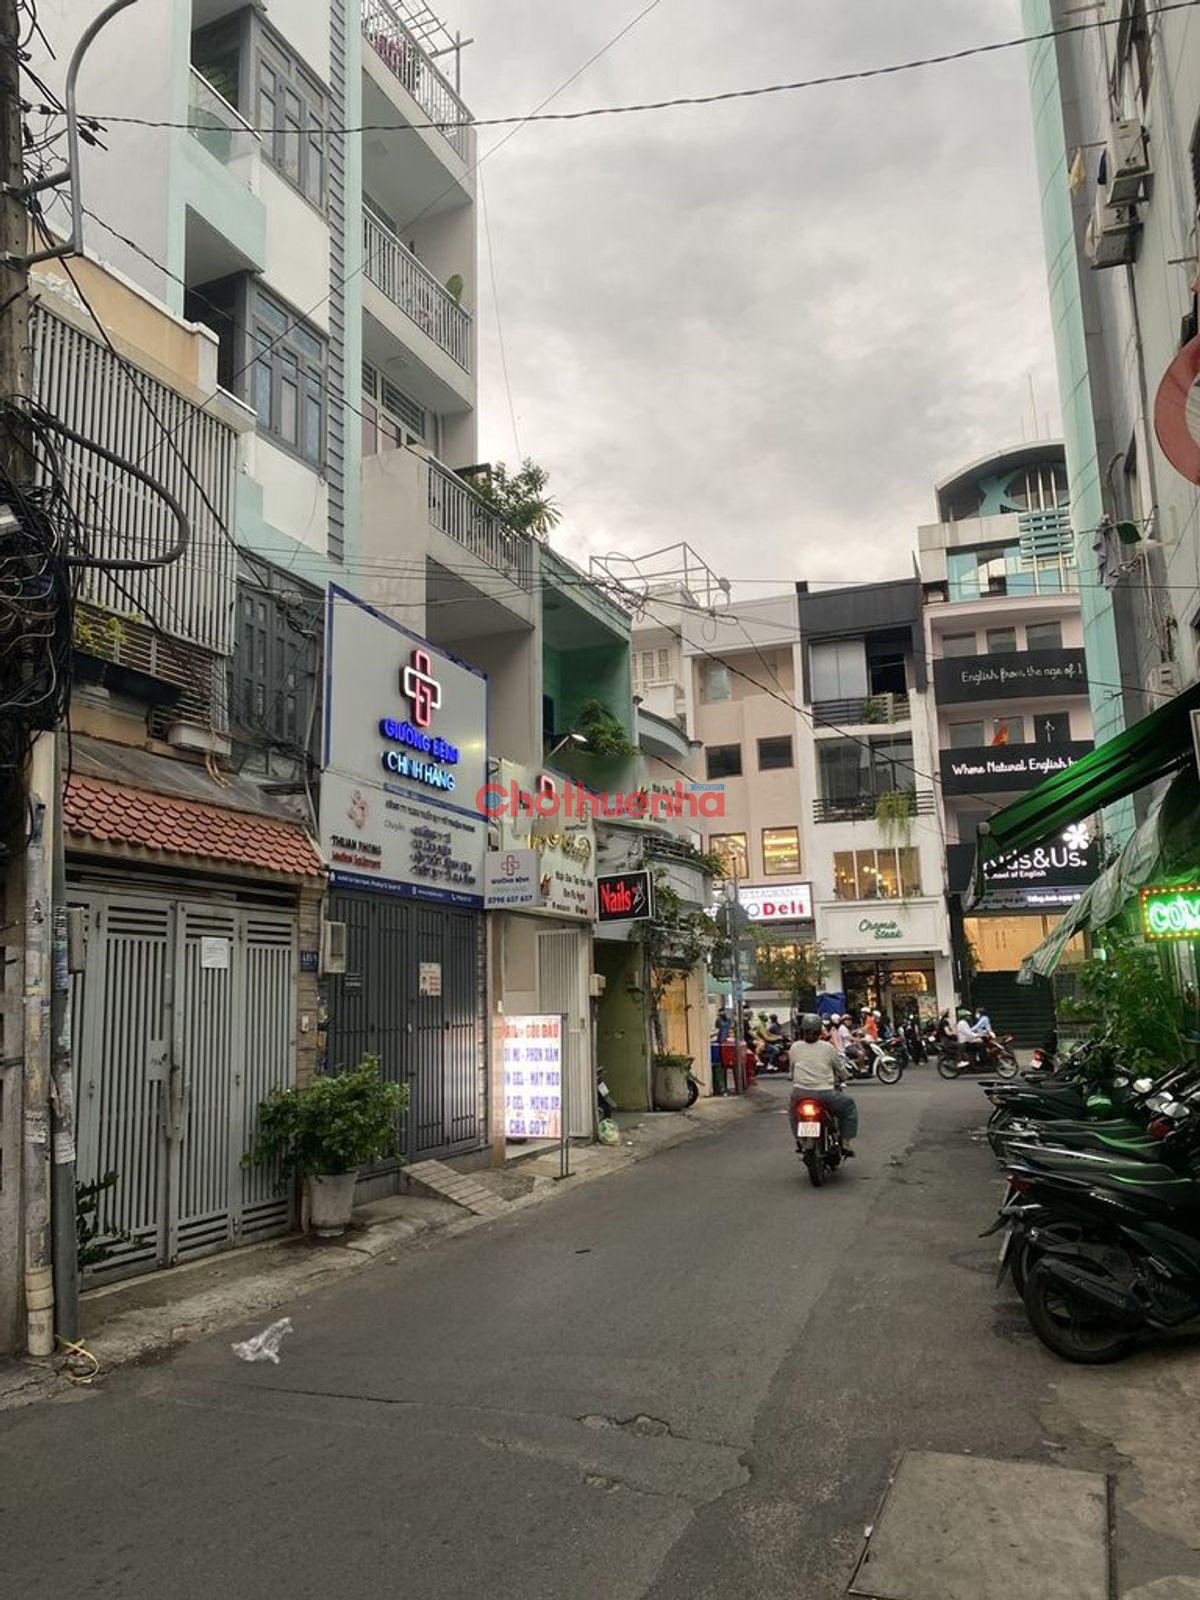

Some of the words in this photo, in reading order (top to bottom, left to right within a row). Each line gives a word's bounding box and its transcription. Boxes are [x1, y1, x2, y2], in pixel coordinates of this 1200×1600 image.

[961, 669, 1000, 685] English
[1026, 665, 1042, 677] the
[1044, 666, 1063, 680] age
[1064, 662, 1075, 677] of
[951, 763, 986, 776] Where
[986, 759, 1028, 774] Natural
[1028, 757, 1067, 774] English
[600, 880, 631, 913] Nails
[762, 901, 804, 916] Deli
